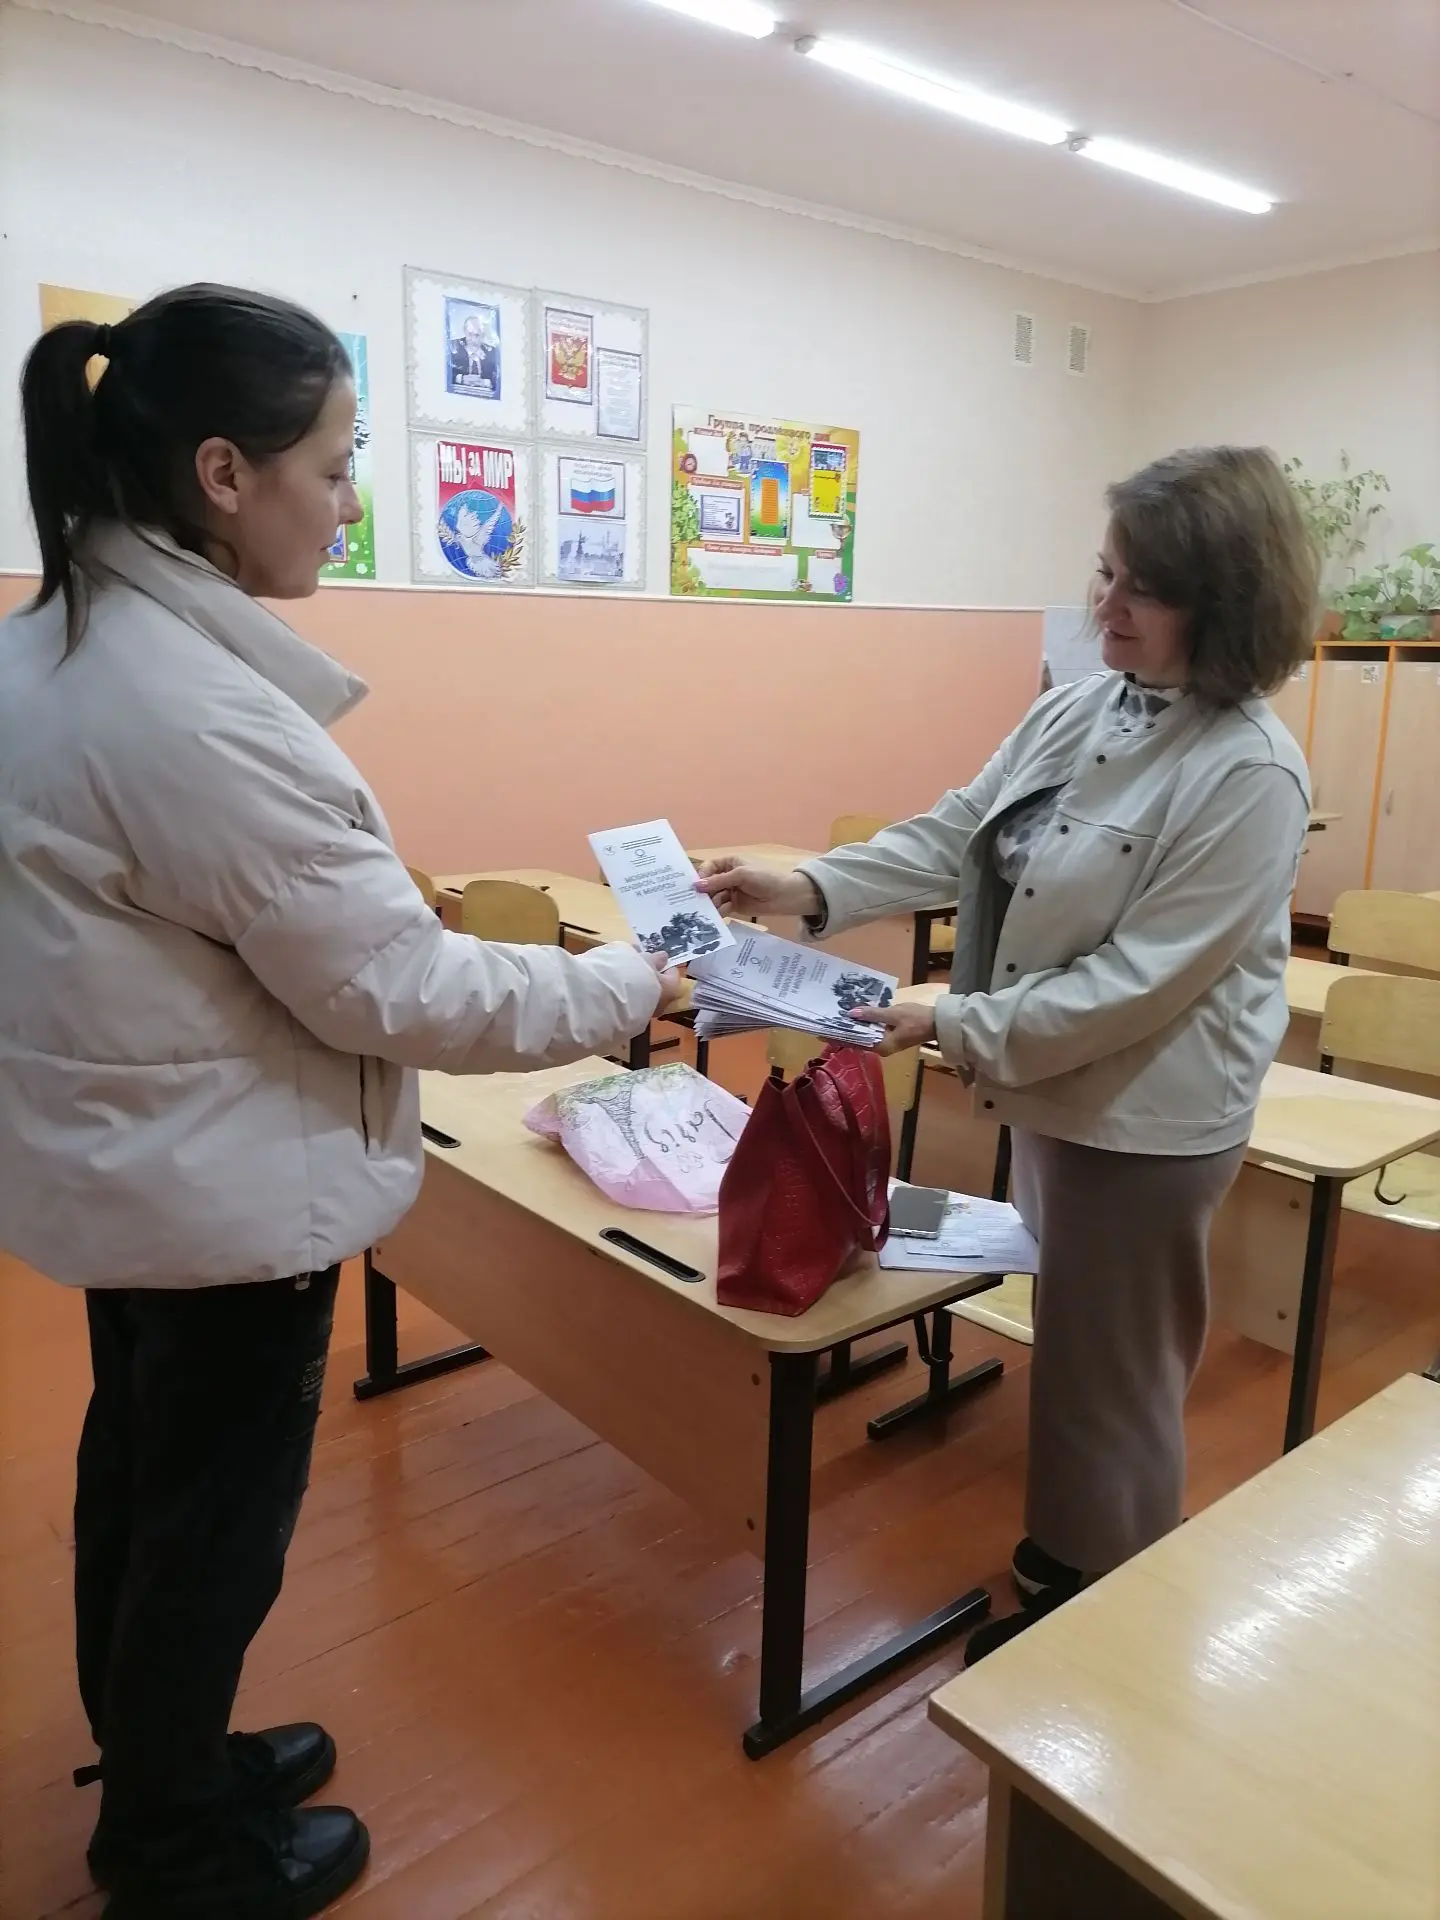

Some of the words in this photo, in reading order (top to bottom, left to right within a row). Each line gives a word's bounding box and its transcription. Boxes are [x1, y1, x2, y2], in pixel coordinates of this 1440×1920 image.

[707, 414, 745, 430] Группа
[440, 444, 467, 484] МЫ
[482, 450, 513, 489] МИР
